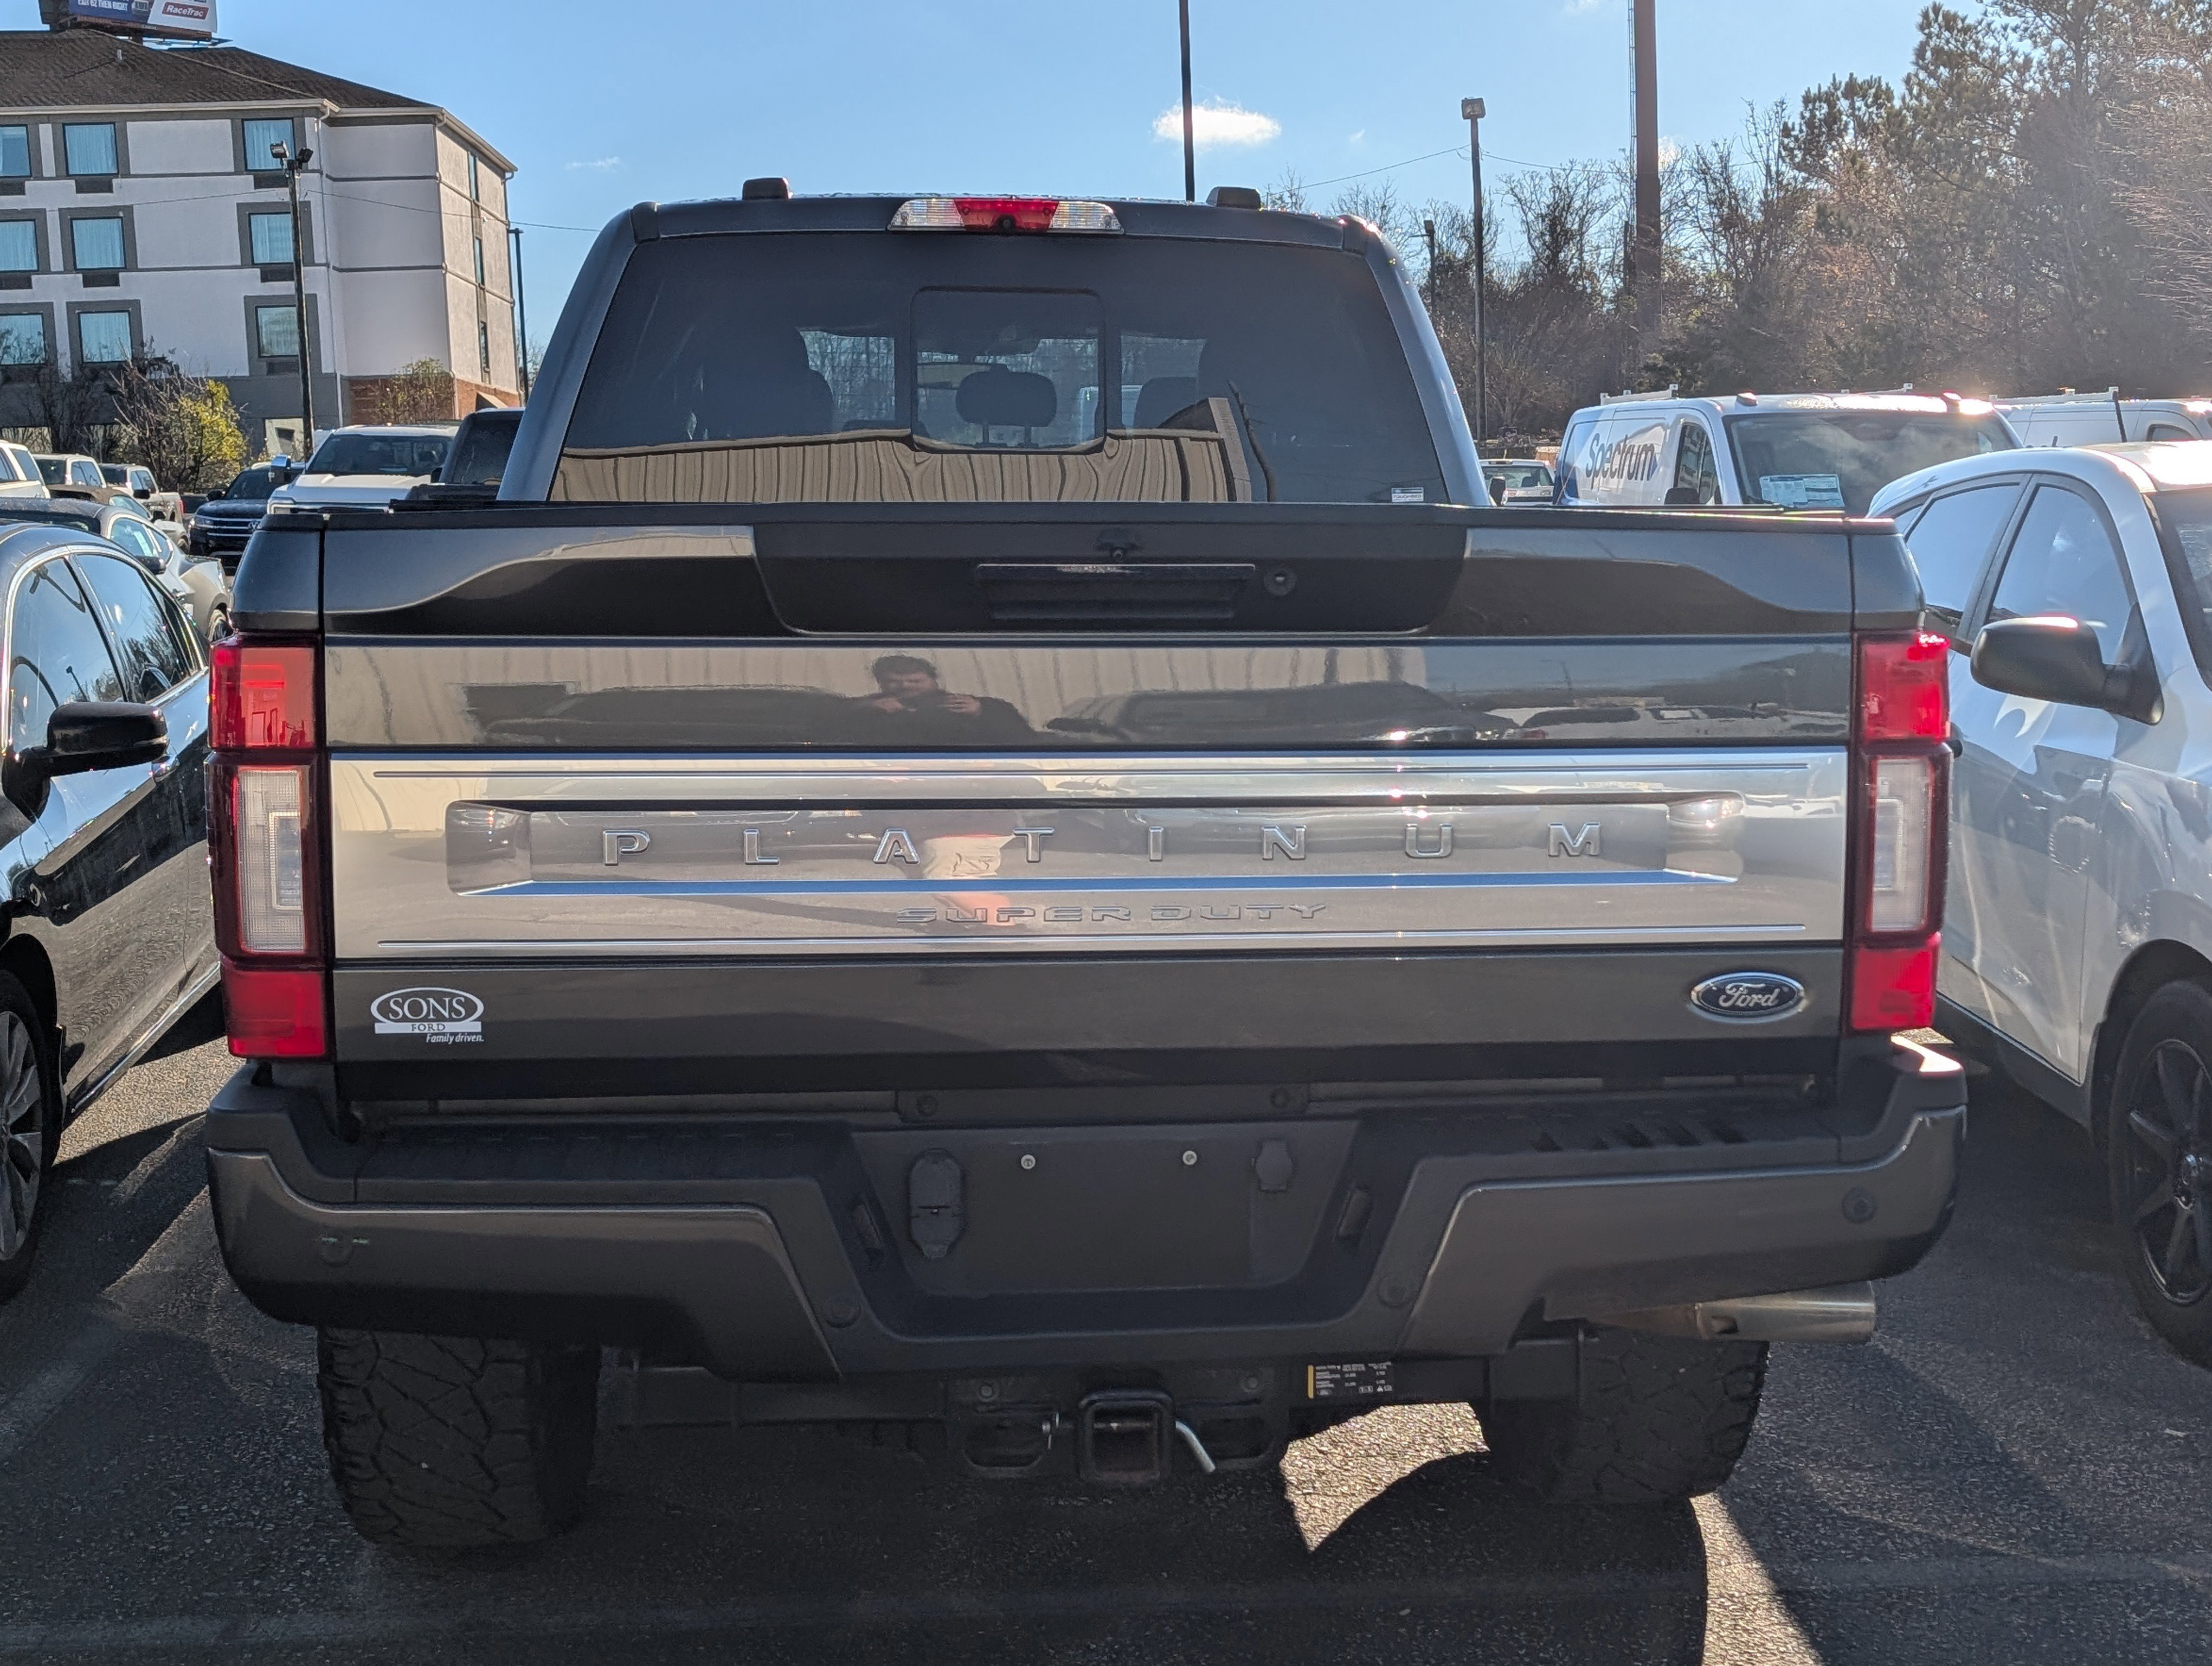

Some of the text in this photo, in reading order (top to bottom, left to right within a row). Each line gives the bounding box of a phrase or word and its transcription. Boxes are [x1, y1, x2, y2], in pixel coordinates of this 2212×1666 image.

[98, 0, 112, 9] THEN
[166, 5, 204, 17] RaceTrac
[1586, 433, 1655, 490] Spectrum
[603, 822, 1600, 866] PLATINUM
[897, 904, 1326, 923] SUPER DUTY
[1718, 982, 1781, 1007] Ford
[389, 996, 466, 1020] SONS
[411, 1023, 446, 1031] FORD
[426, 1033, 454, 1045] Family
